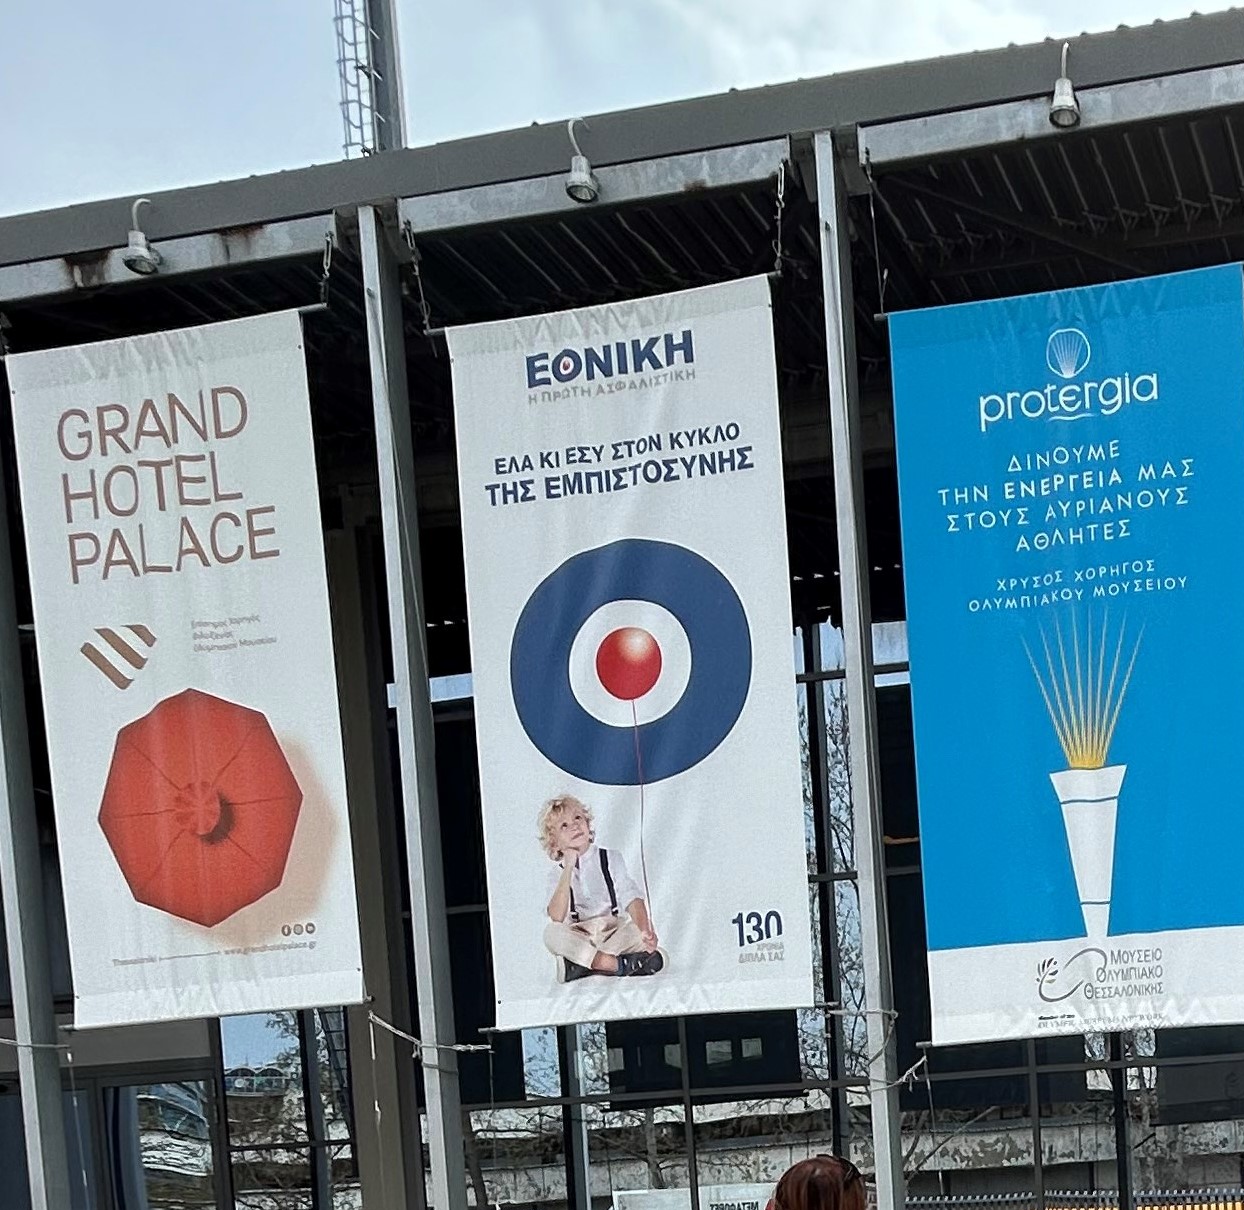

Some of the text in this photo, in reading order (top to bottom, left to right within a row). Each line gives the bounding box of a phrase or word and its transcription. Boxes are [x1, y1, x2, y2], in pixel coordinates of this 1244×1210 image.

[541, 384, 592, 403] ΠΡΩΤΗ
[596, 368, 696, 396] ΑΣΦΑΛΙΣΤΙΚΗ
[979, 372, 1158, 432] protergia
[57, 386, 248, 461] GRAND
[494, 422, 740, 475] ΕΛΑ ΚΙ ΕΣΥ ΣΤΟΝ ΚΥΚΛΟ
[1007, 439, 1120, 472] ΔΙΝΟΥΜΕ
[62, 451, 243, 523] HOTEL
[484, 445, 754, 506] ΤΗΣ ΕΜΠΙΣΤΟΣΥΝΗΣ
[938, 458, 1194, 505] ΤΗΝ ΕΝΕΡΓΕΙΑ ΜΑΣ
[947, 486, 1188, 532] ΣΤΟΥΣ ΑΥΡΙΑΝΟΥΣ
[68, 505, 280, 584] PALACE
[1016, 519, 1131, 552] ΑΘΛΗΤΕΣ
[968, 576, 1187, 612] ΟΛΥΜΠΙΑΚΟΥ ΜΟΥΣΕΙΟΥ
[997, 559, 1155, 591] ΧΡΥΣΟΣ ΧΟΡΗΓΟΣ
[732, 910, 783, 947] 130
